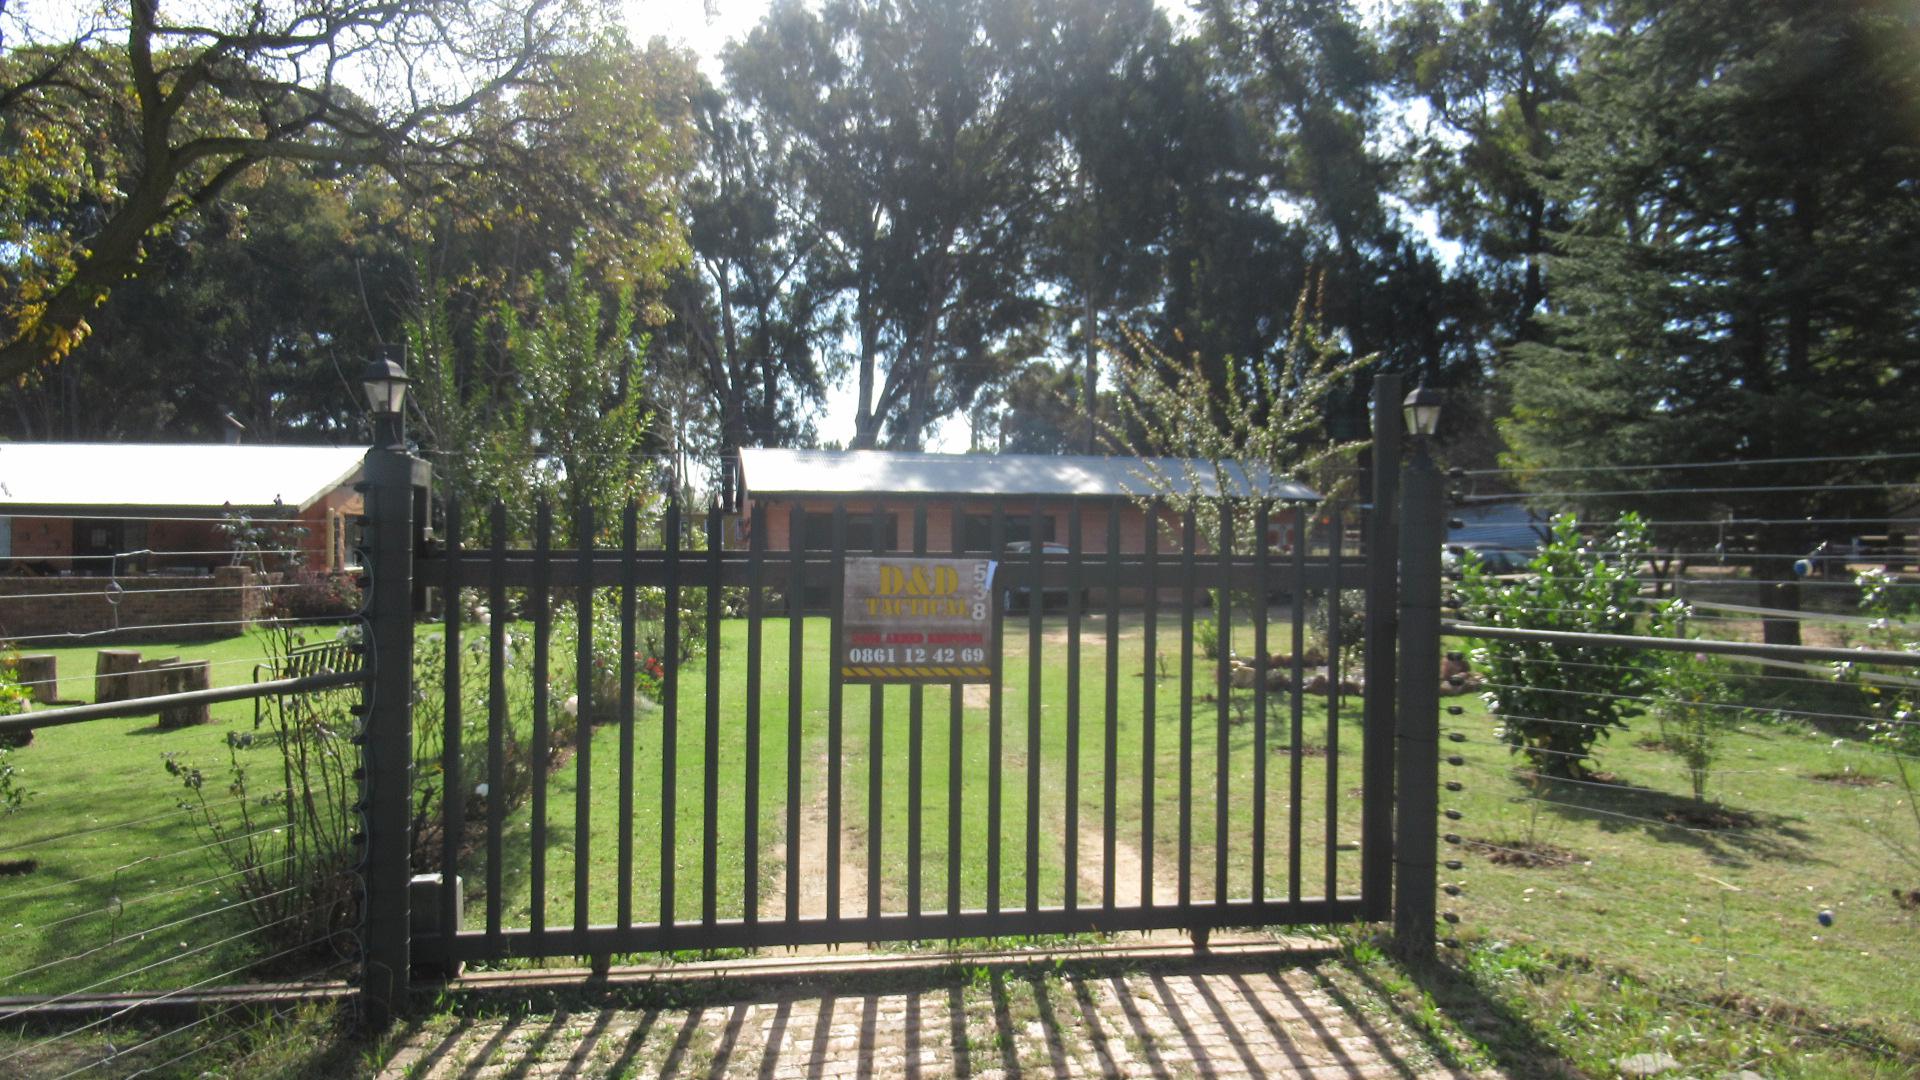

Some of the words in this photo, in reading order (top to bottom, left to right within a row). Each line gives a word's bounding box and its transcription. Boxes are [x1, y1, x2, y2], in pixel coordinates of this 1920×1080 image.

[880, 565, 959, 595] D&D
[864, 598, 970, 616] TACTICAL
[849, 648, 896, 663] 0861
[904, 648, 926, 663] 12
[932, 648, 955, 663] 42
[961, 648, 984, 663] 69
